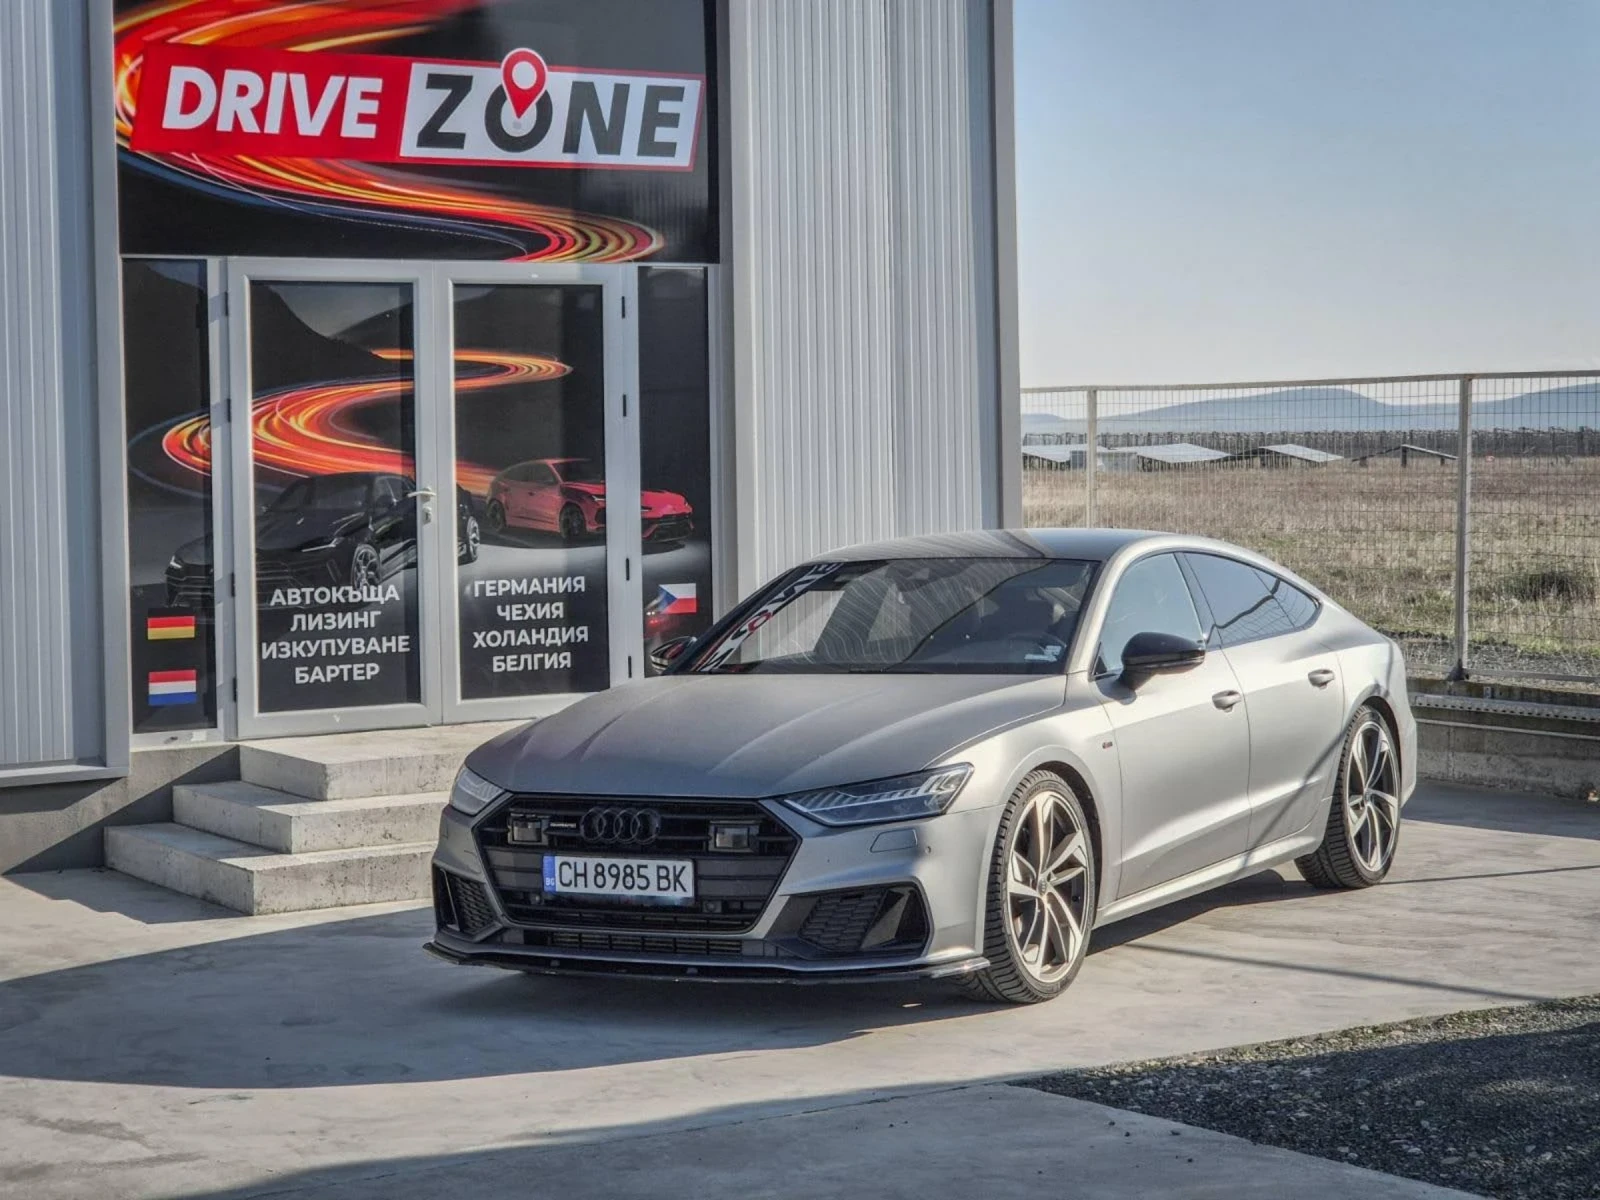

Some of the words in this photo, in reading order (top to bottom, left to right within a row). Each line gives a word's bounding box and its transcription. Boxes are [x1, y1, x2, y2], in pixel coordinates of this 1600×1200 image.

[162, 66, 383, 138] DRIVE
[416, 73, 686, 158] ZONE
[270, 584, 400, 606] АВТОКЪЩА
[474, 576, 585, 597] ГЕРМАНИЯ
[290, 611, 382, 632] ЛИЗИНГ
[496, 602, 564, 621] ЧЕХИЯ
[261, 635, 411, 660] ИЗКУПУВАНЕ
[472, 625, 589, 649] ХОЛАНДИЯ
[492, 651, 572, 673] БЕЛГИЯ
[295, 662, 381, 685] БАРТЕР
[545, 877, 555, 886] BG
[558, 861, 588, 888] CH
[593, 863, 650, 891] 8985
[656, 865, 688, 893] BK
